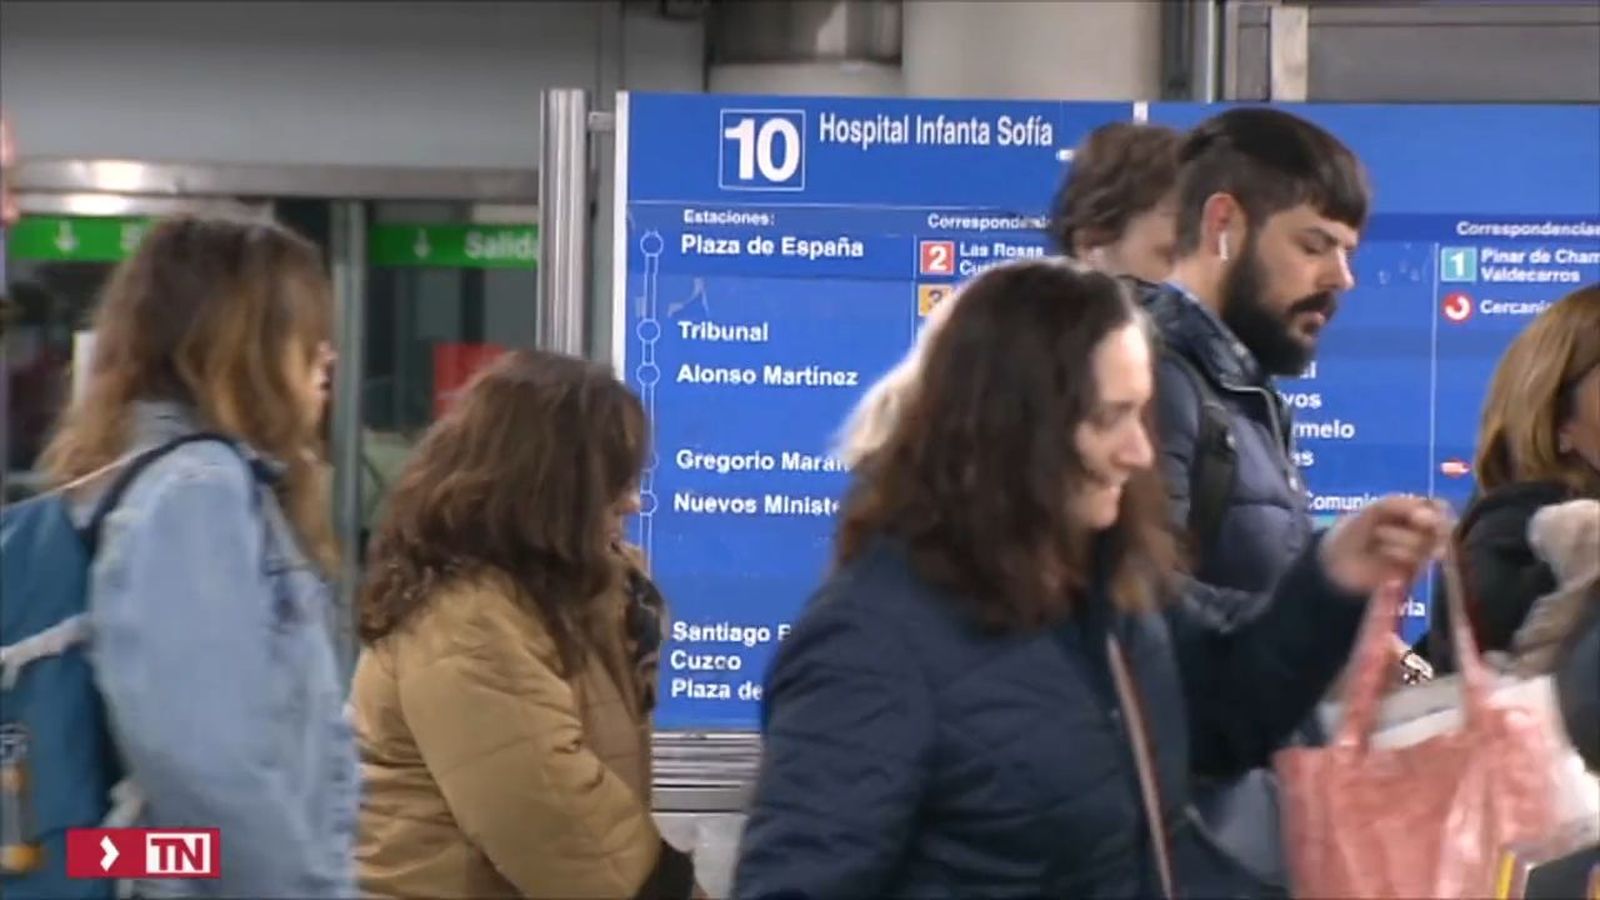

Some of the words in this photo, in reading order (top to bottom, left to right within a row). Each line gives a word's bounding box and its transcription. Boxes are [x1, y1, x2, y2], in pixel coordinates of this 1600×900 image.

[818, 112, 909, 150] Hospital
[915, 115, 990, 145] Infanta
[996, 115, 1053, 146] Sofía
[724, 117, 801, 182] 10
[683, 209, 776, 226] Estaciones:
[681, 233, 741, 254] Plaza
[746, 235, 775, 255] de
[781, 236, 865, 261] España
[928, 244, 949, 272] 2
[959, 241, 990, 258] Las
[1480, 246, 1527, 264] Pinar
[1529, 247, 1552, 264] de
[1451, 251, 1466, 277] 1
[1480, 266, 1581, 283] Valdecarros
[677, 320, 769, 342] Tribunal
[676, 363, 757, 385] Alonso
[763, 364, 859, 386] Martínez
[676, 449, 775, 474] Gregorio
[673, 492, 757, 513] Nuevos
[672, 620, 771, 648] Santiago
[670, 649, 742, 671] Cuzco
[671, 677, 731, 699] Plaza
